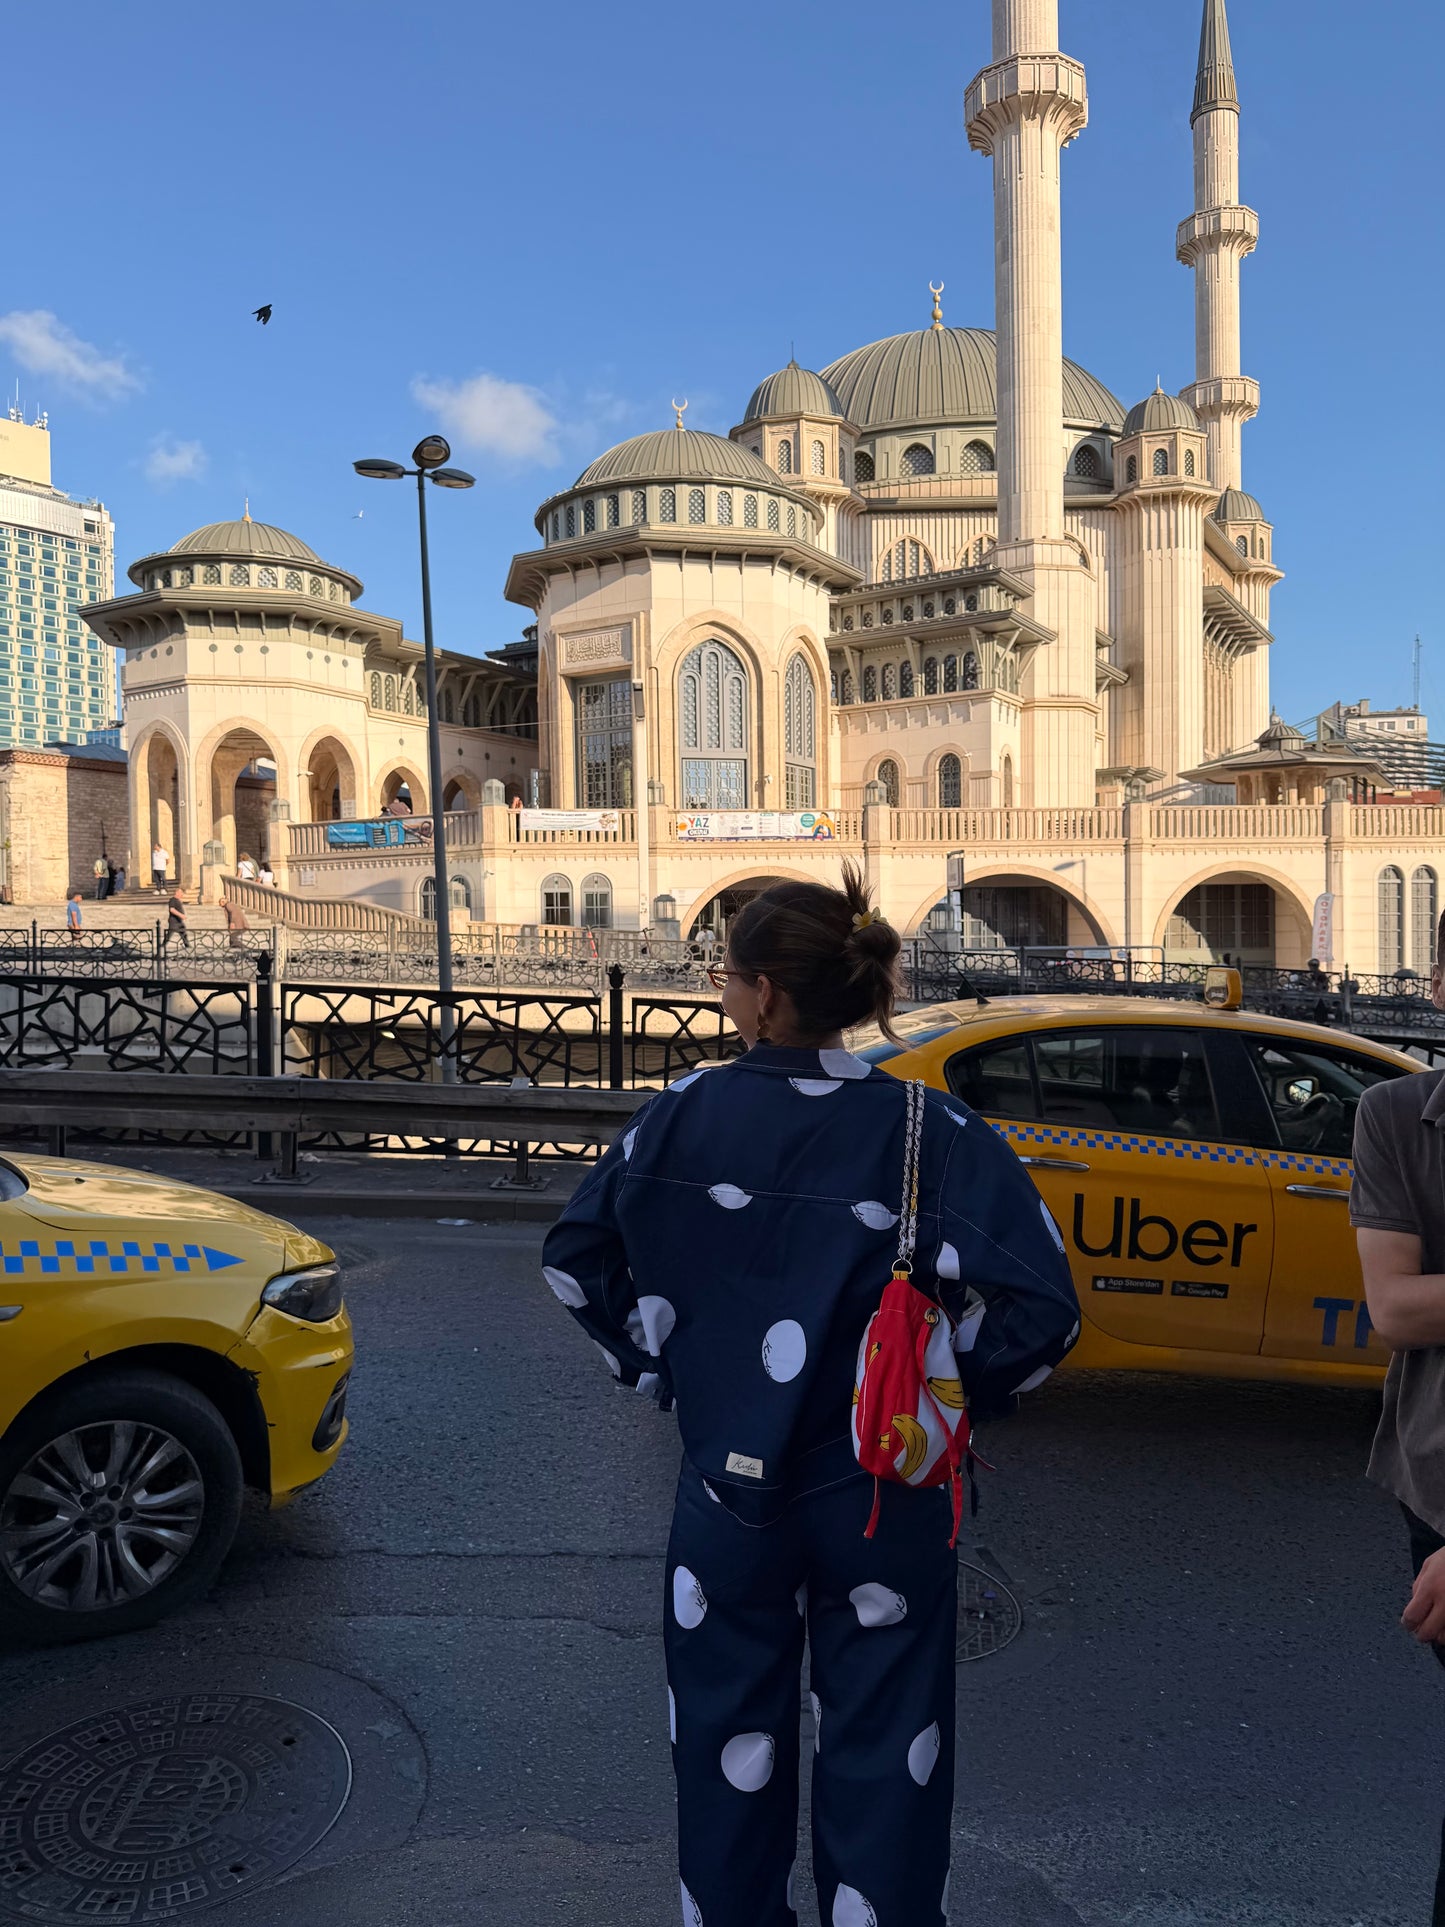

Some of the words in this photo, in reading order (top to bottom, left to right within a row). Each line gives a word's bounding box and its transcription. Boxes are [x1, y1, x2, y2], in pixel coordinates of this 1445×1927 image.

[688, 817, 709, 828] YAZ
[1072, 1193, 1258, 1268] Uber
[1107, 1278, 1121, 1286] App
[1187, 1287, 1210, 1296] Google
[1211, 1288, 1225, 1297] Play
